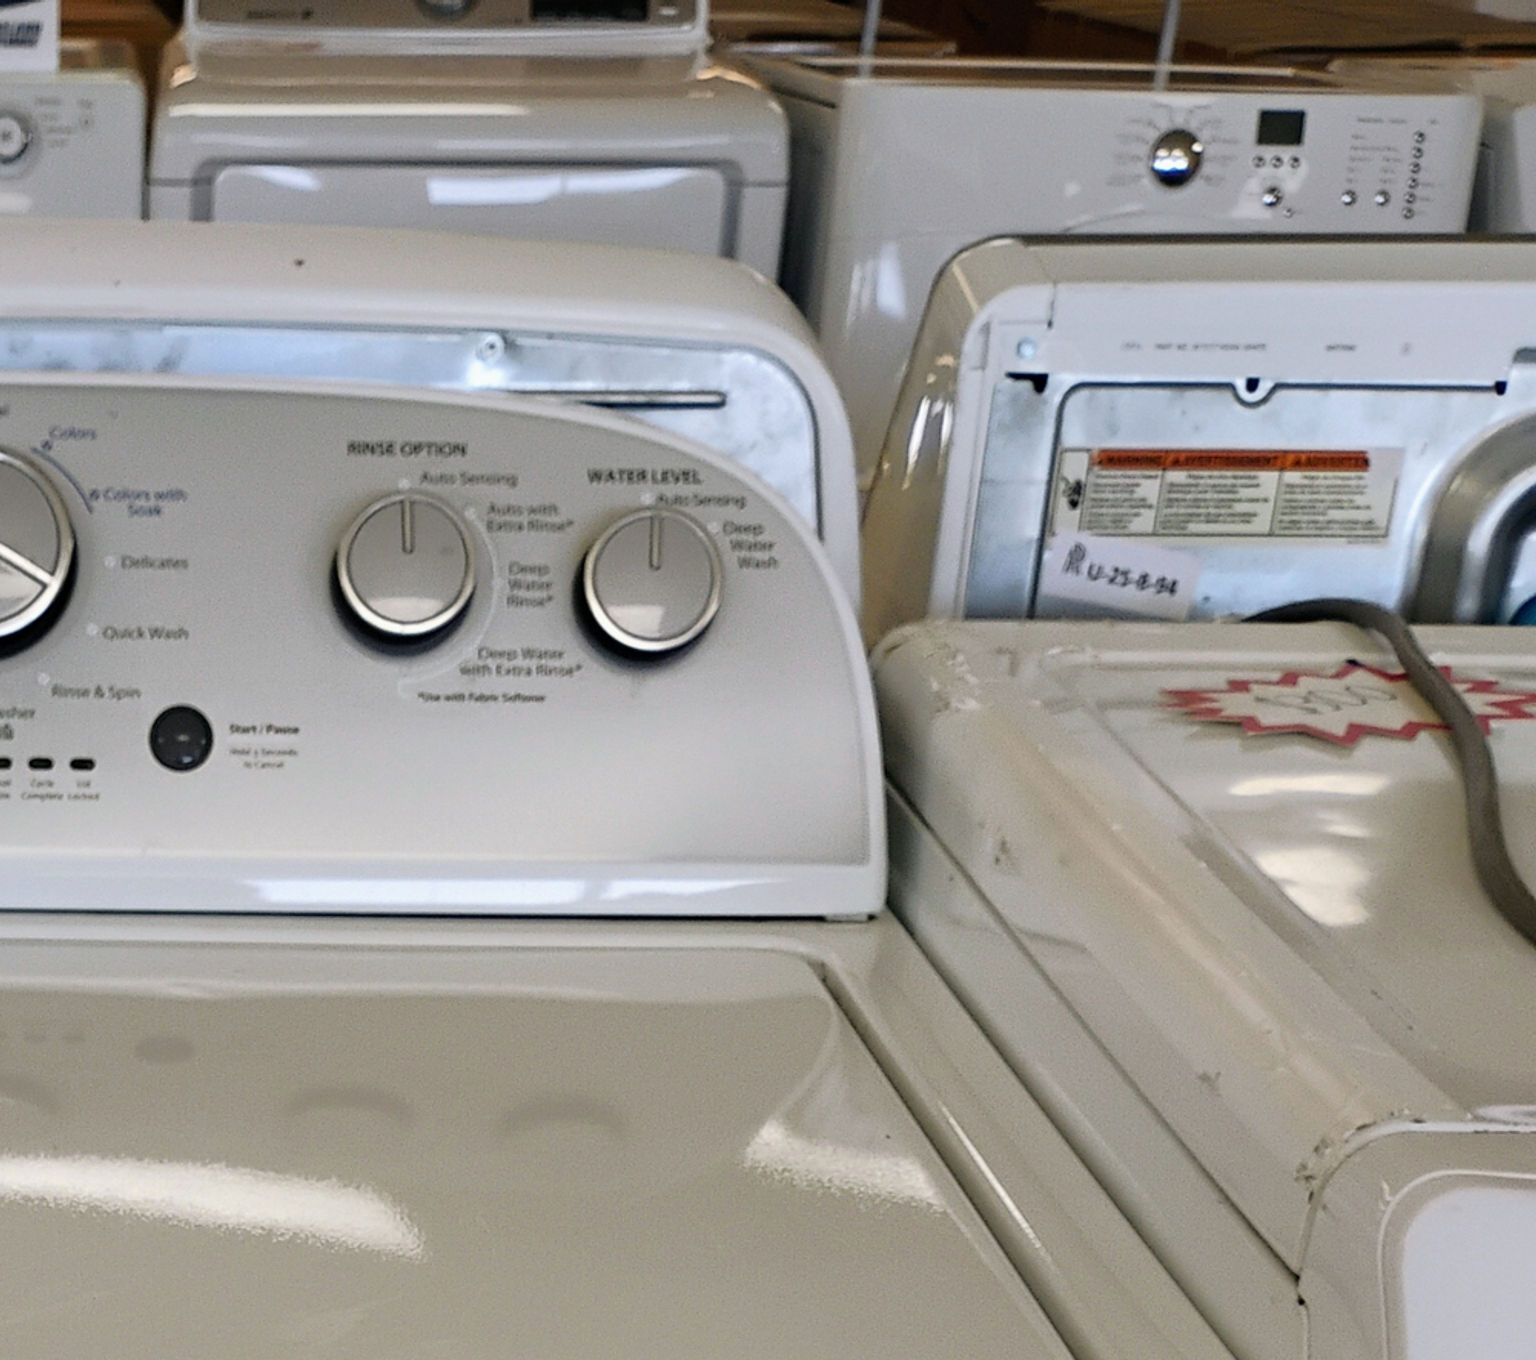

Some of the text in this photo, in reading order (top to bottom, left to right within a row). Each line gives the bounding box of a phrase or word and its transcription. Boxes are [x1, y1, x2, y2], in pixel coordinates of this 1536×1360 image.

[49, 425, 96, 440] Colors
[348, 440, 467, 457] RINSE OPTION
[420, 472, 519, 488] Auto Sensing
[588, 470, 703, 485] WATER LEVEL
[102, 487, 150, 501] Colors
[487, 504, 524, 517] Auto
[486, 520, 524, 533] Extra
[723, 521, 765, 535] Deep
[120, 555, 189, 570] Delicates
[509, 561, 550, 576] Deep
[102, 625, 190, 641] Quick Wash
[478, 647, 565, 663] Deep Water
[51, 684, 91, 699] Rinse
[229, 723, 257, 735] Start
[266, 724, 300, 735] Pause
